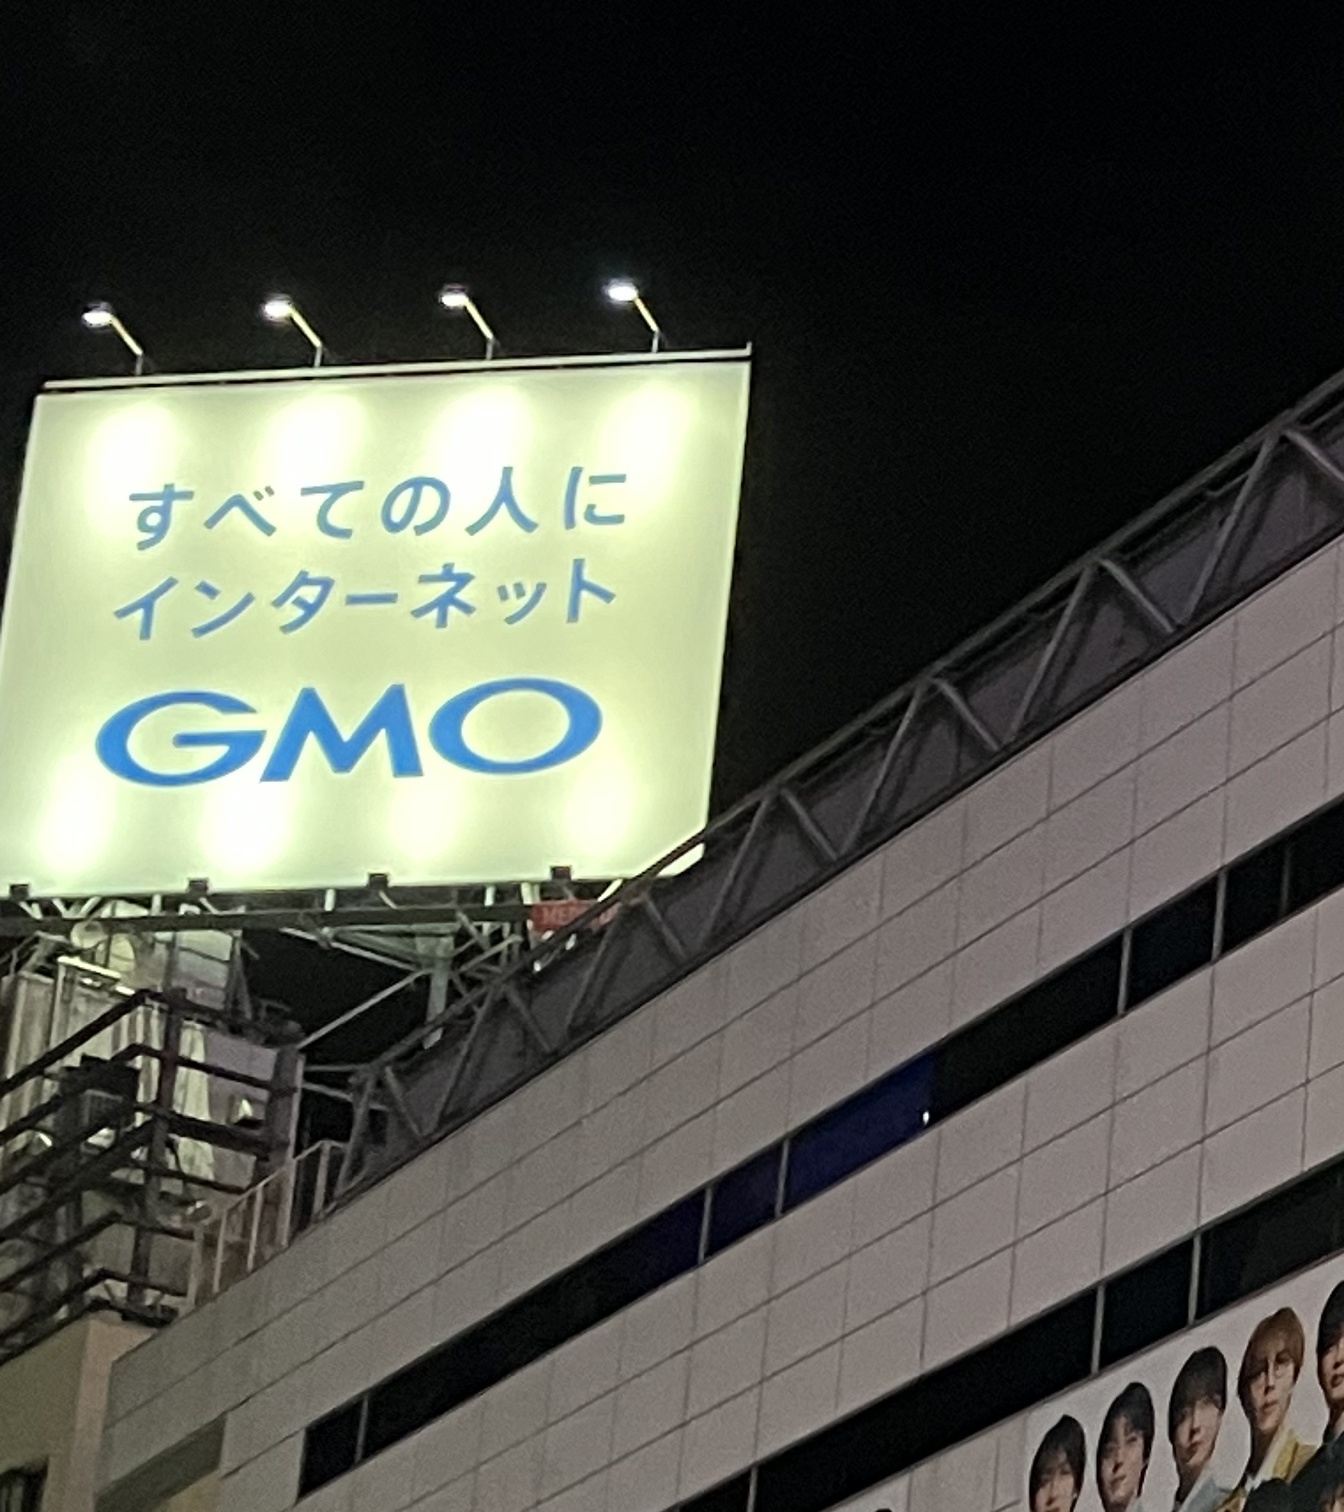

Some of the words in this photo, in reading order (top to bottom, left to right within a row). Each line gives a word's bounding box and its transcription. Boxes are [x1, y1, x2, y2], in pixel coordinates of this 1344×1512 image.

[128, 466, 627, 551] すべての人に
[114, 558, 616, 641] インターネット
[94, 677, 603, 788] GMO
